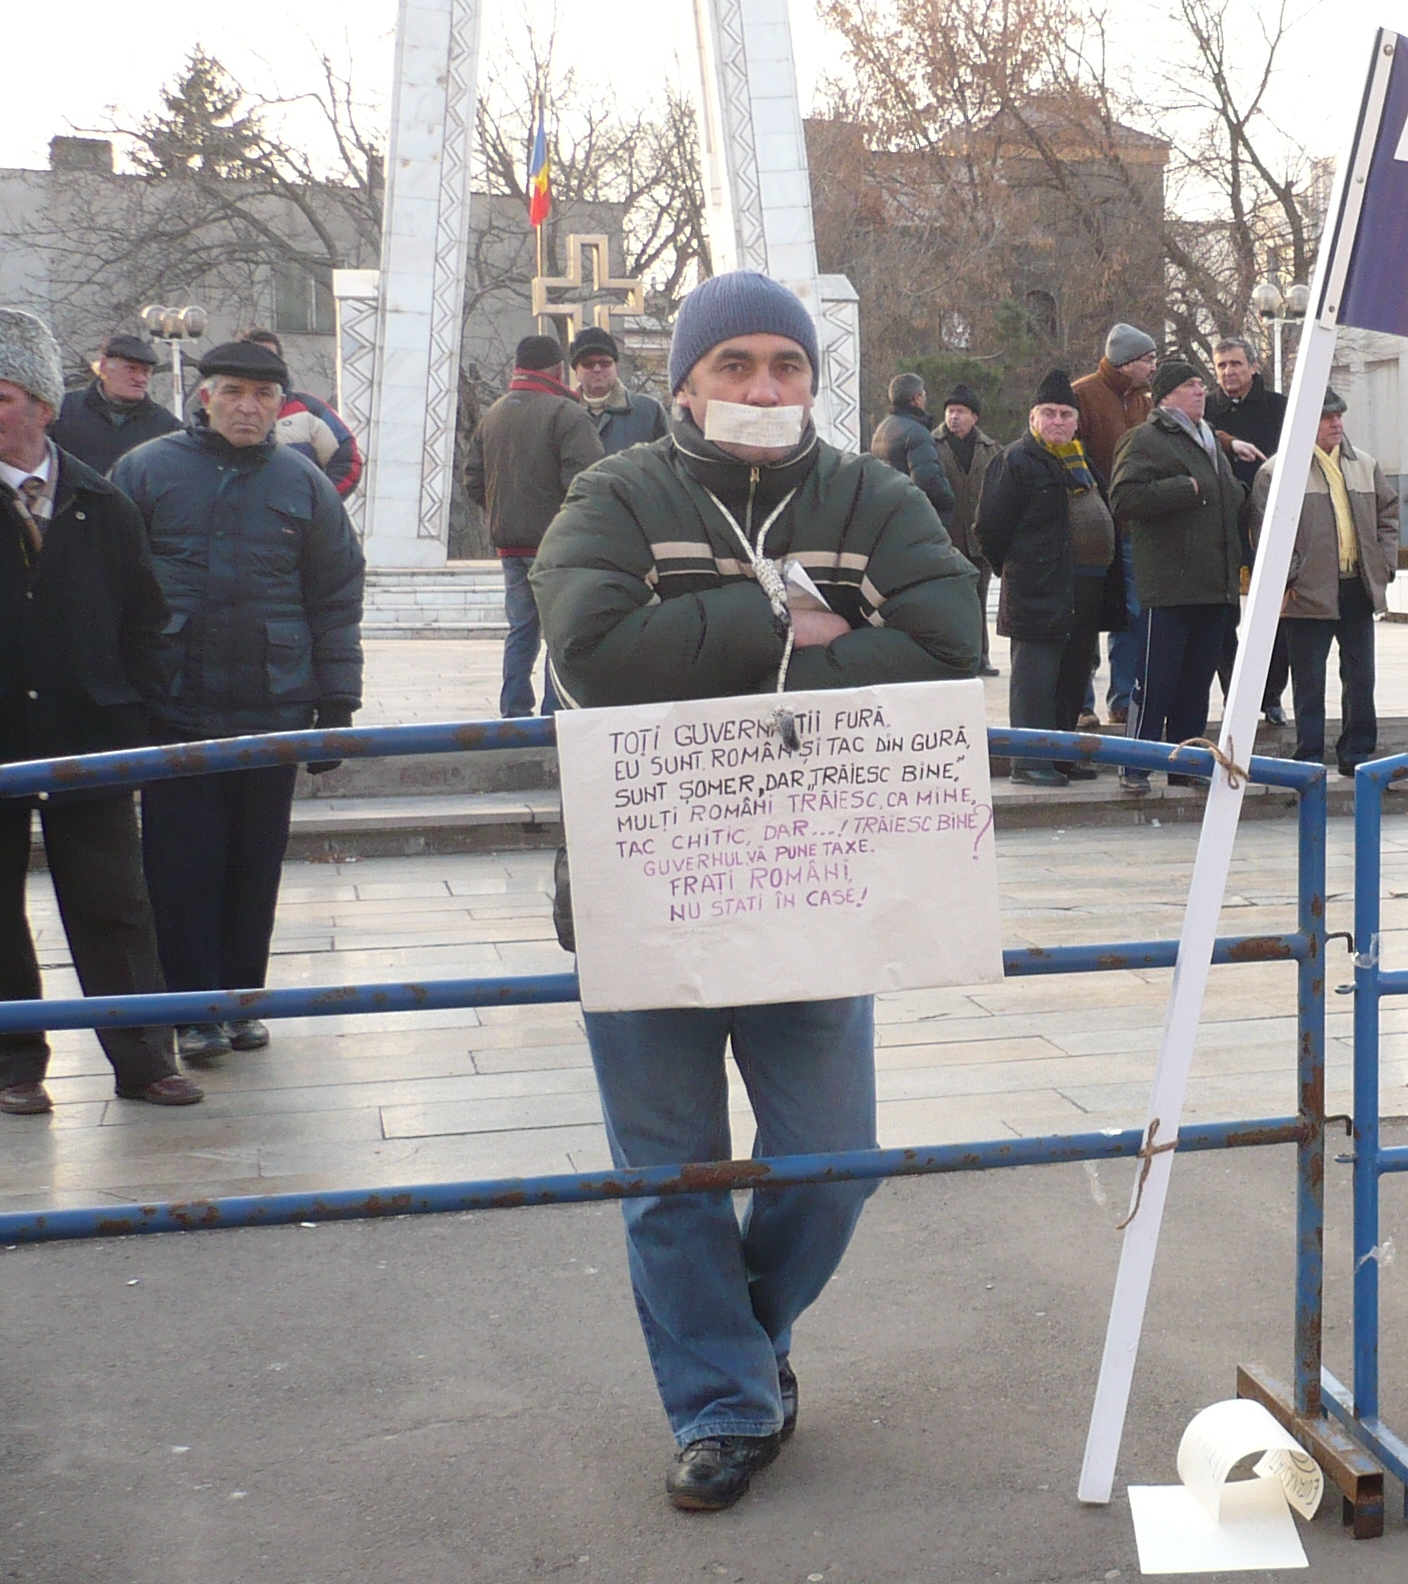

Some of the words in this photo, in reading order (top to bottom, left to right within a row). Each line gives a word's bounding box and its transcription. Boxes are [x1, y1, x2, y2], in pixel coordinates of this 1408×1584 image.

[615, 759, 639, 781] EU
[827, 737, 864, 756] TAC
[615, 782, 667, 808] SUNT
[887, 792, 908, 807] CA
[616, 839, 655, 858] TAC
[775, 843, 818, 862] PUNE
[670, 902, 701, 921] NU
[807, 887, 868, 908] CASE!
